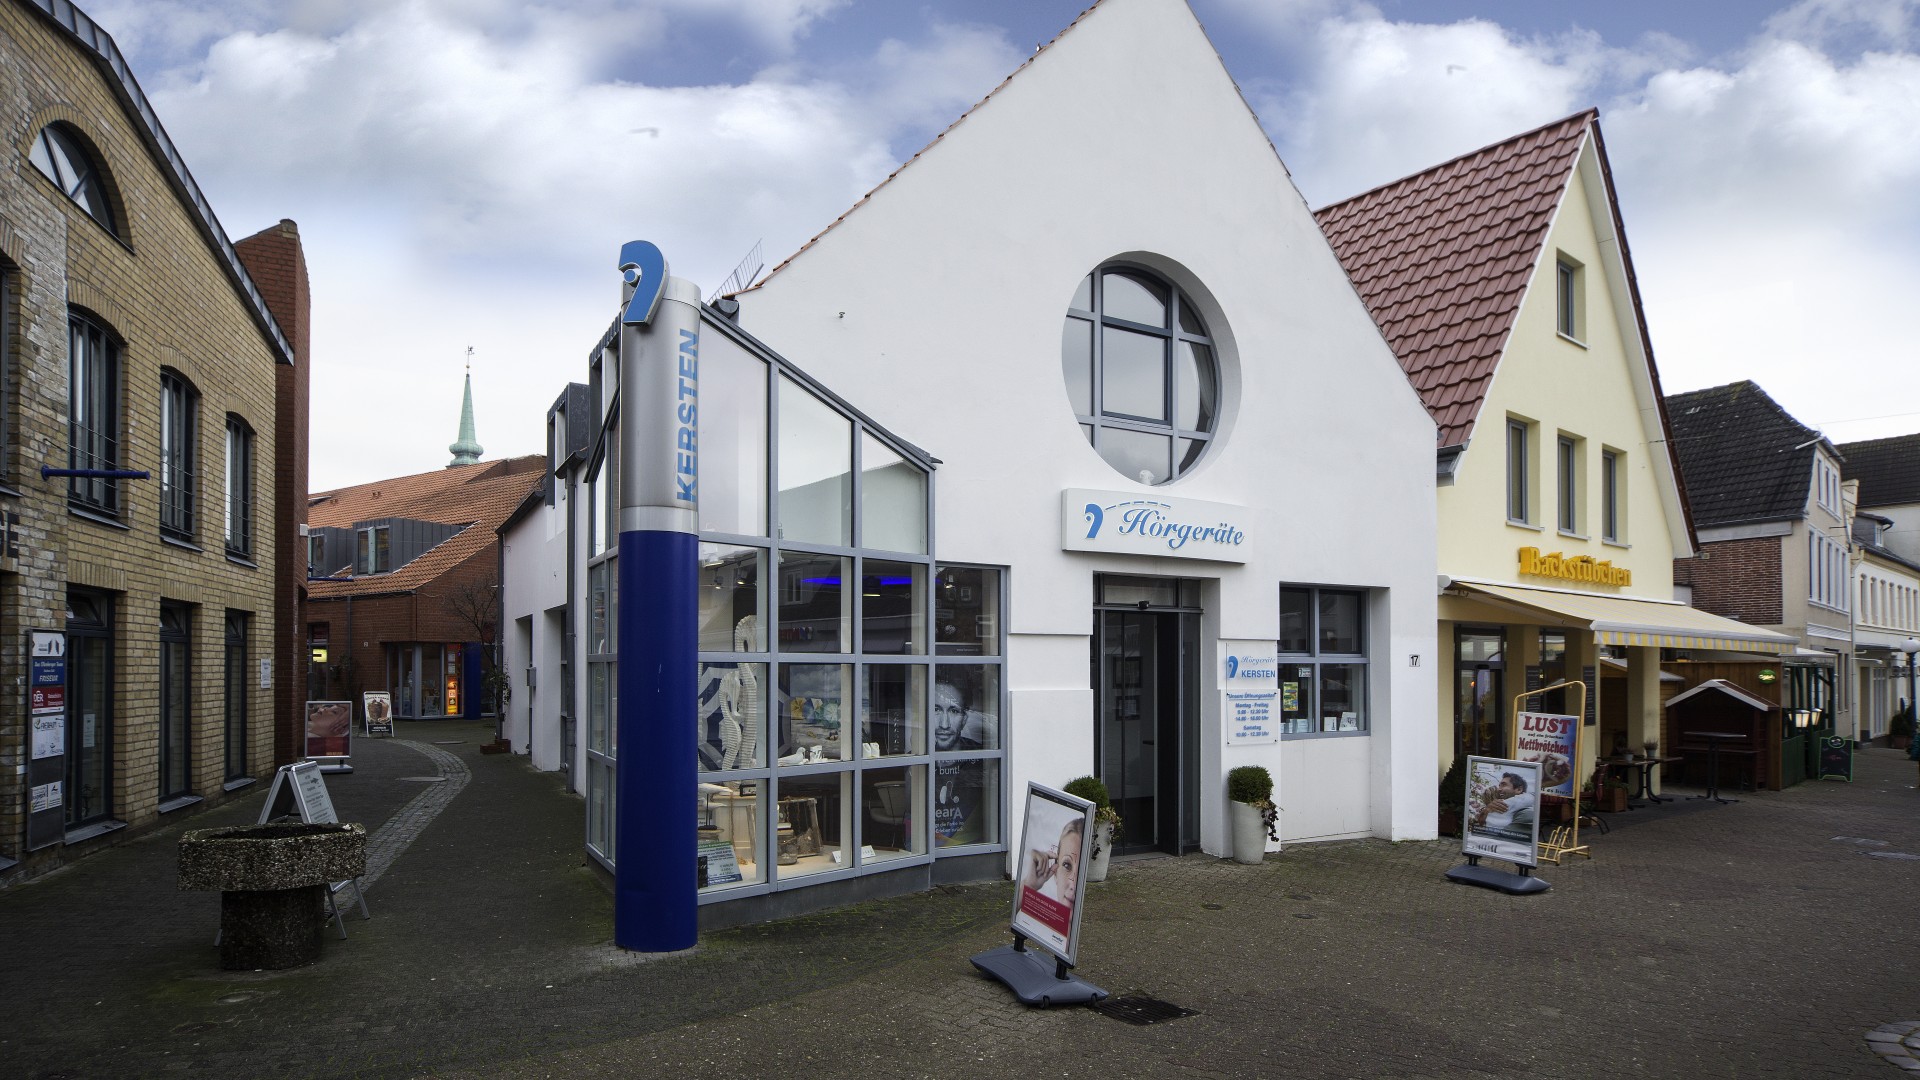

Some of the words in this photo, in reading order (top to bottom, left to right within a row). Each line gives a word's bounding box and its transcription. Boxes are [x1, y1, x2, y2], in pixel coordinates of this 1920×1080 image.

[677, 328, 699, 503] KERSTEN
[1118, 508, 1245, 550] Hörgeräte
[1520, 547, 1632, 587] Backstübchen
[1241, 656, 1275, 665] Hörgeräte
[1410, 655, 1419, 667] 17
[1242, 670, 1275, 678] KERSTEN
[1523, 715, 1572, 734] LUST
[1518, 737, 1569, 755] Mettbrötchen
[939, 765, 960, 775] bunt!
